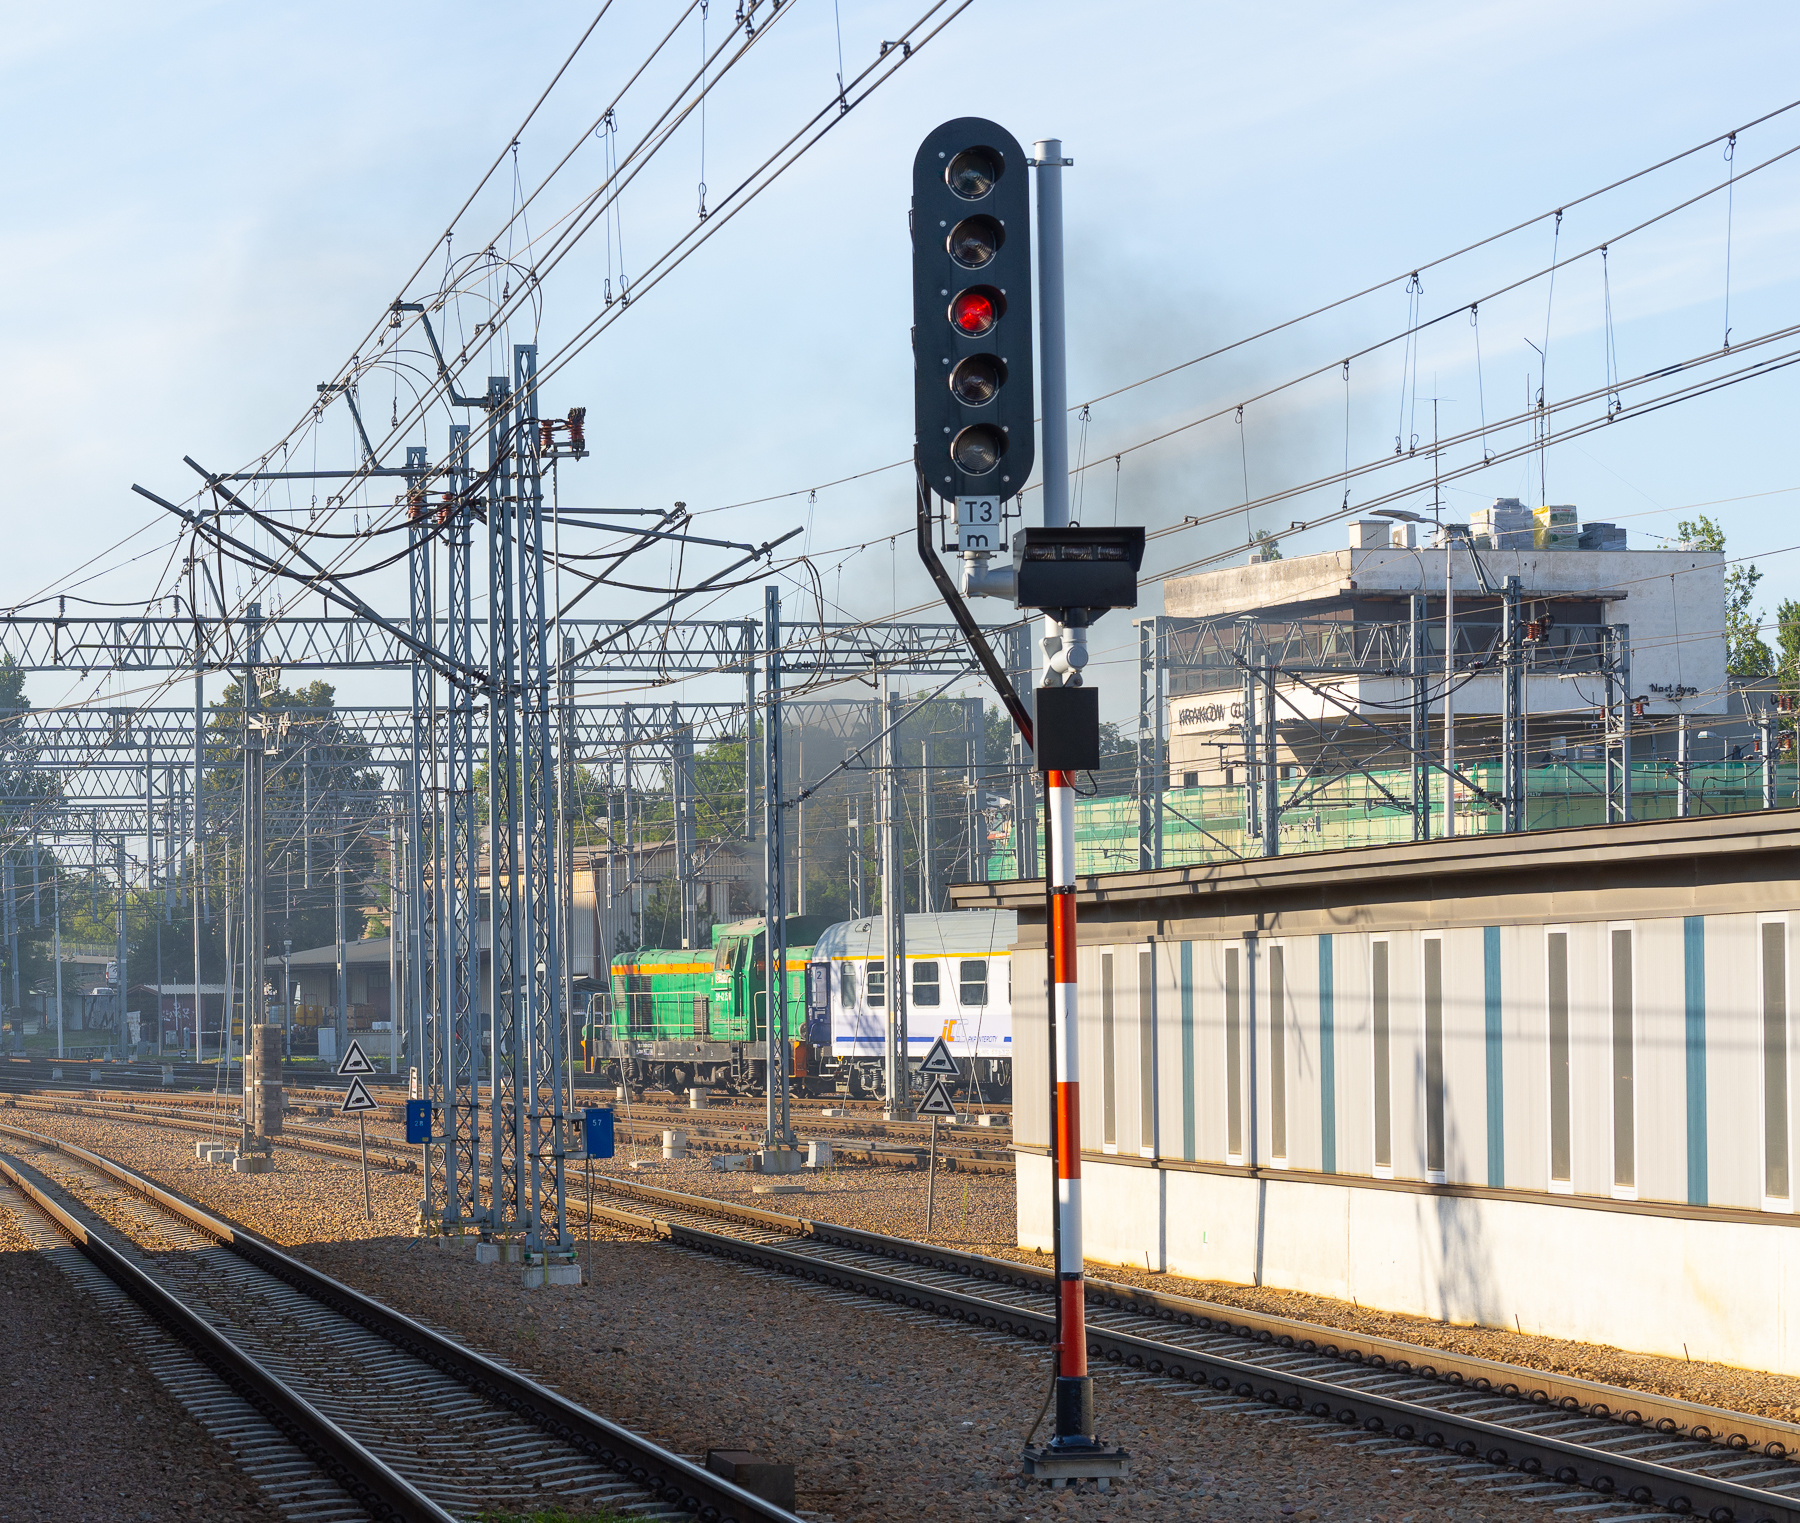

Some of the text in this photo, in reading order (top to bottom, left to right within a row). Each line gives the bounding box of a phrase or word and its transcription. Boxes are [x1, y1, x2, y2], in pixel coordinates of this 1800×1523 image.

[964, 501, 992, 523] T3
[966, 534, 989, 548] m
[816, 970, 823, 980] 2
[592, 1118, 602, 1127] 57
